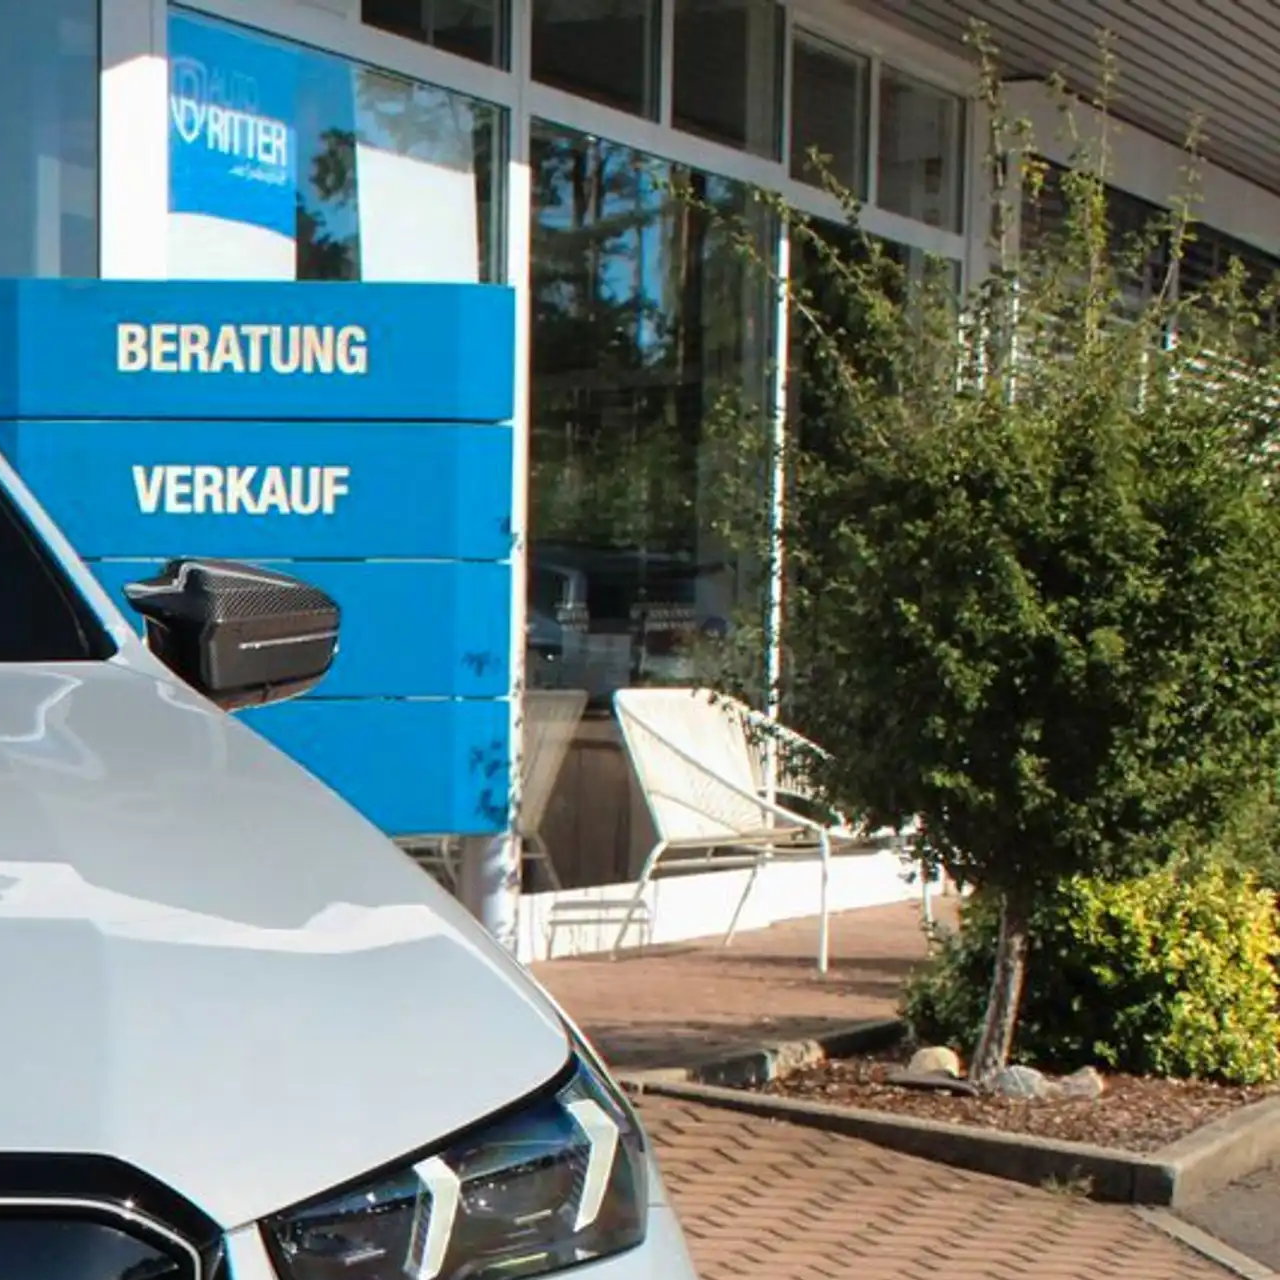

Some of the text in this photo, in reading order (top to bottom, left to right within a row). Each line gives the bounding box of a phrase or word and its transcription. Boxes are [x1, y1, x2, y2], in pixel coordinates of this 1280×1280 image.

[206, 104, 287, 167] RITTER
[116, 323, 368, 374] BERATUNG
[131, 464, 351, 515] VERKAUF
